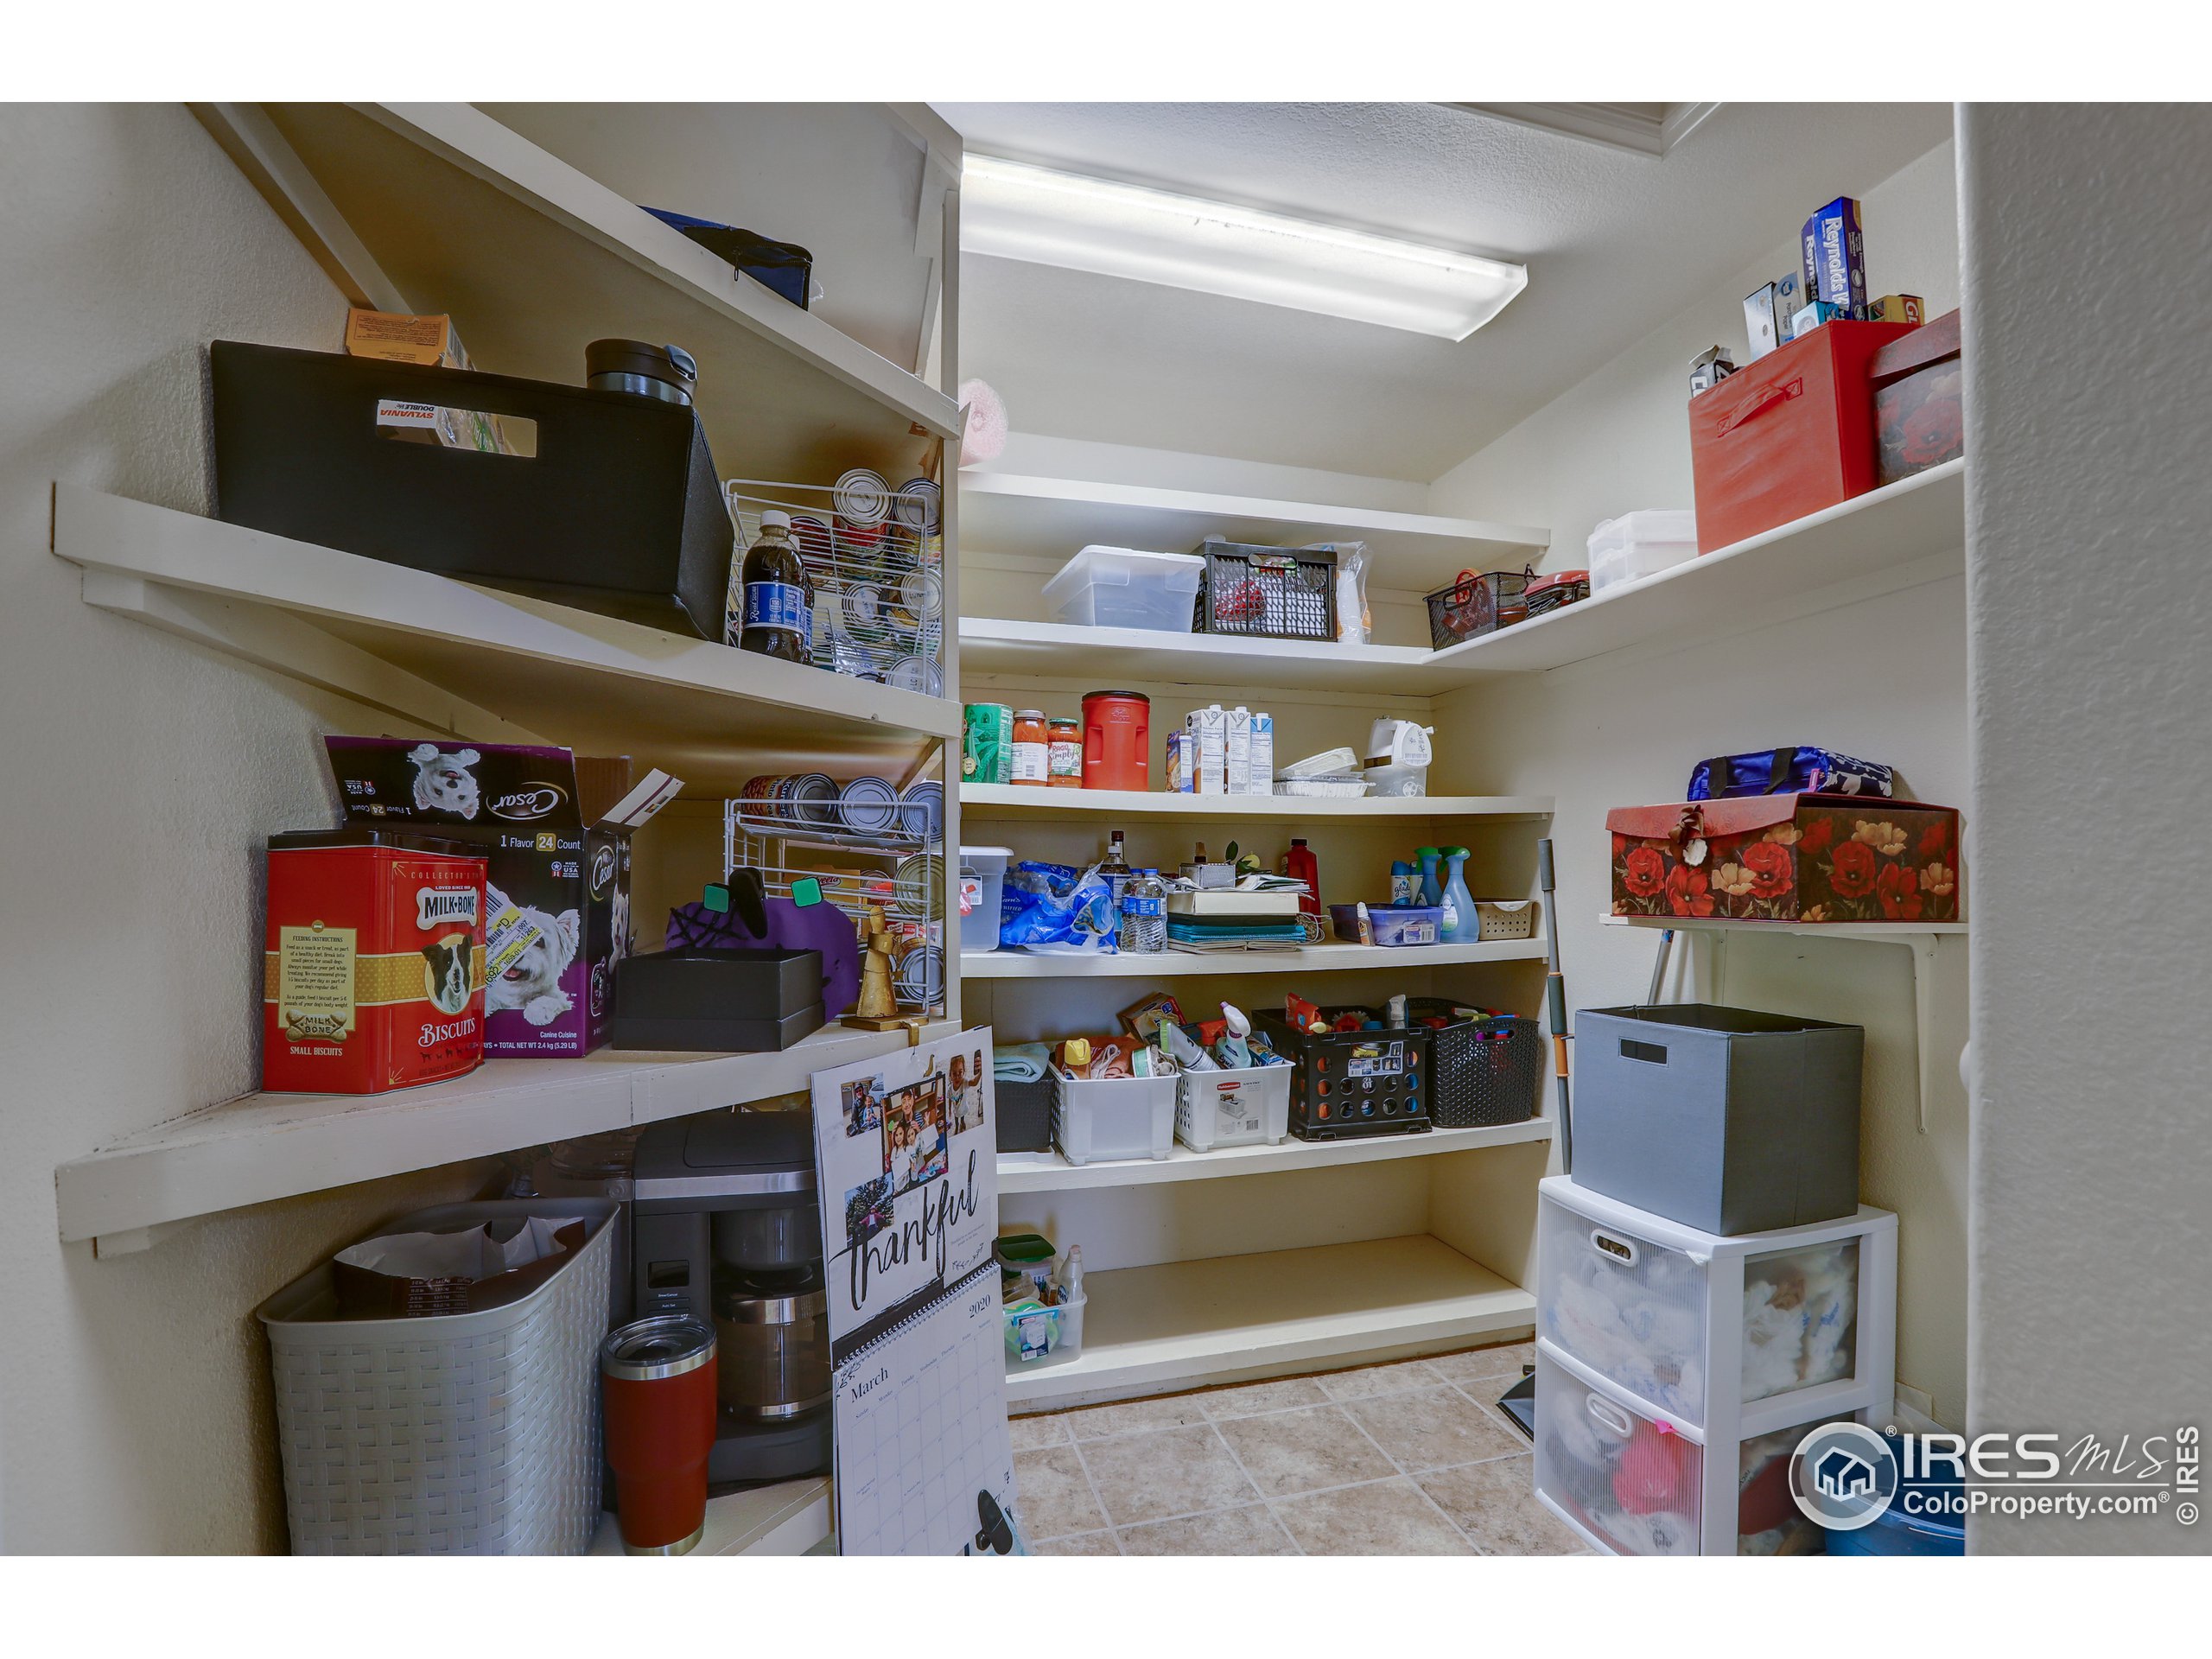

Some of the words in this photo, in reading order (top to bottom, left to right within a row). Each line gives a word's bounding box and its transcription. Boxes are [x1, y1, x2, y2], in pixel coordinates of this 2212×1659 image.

[1823, 214, 1846, 292] Reynolds
[1806, 235, 1818, 301] Reynold
[380, 409, 434, 420] SYLVANIA
[750, 599, 760, 622] Real
[1048, 749, 1077, 761] Simply
[496, 789, 558, 814] Cesar
[372, 805, 385, 814] 24
[386, 806, 405, 815] Flavor
[406, 807, 411, 816] 1
[500, 835, 507, 848] 1
[510, 837, 535, 849] Flavor
[538, 836, 554, 849] 24
[556, 839, 581, 850] Count
[593, 855, 614, 891] Cesar
[305, 1016, 330, 1025] MILK
[289, 1046, 312, 1056] SMALL
[314, 1047, 343, 1057] BISCUITS
[546, 1042, 554, 1051] kg
[554, 1041, 568, 1050] (5.29
[828, 1149, 980, 1312] Thankful
[969, 1294, 991, 1319] 2020
[850, 1367, 889, 1403] March
